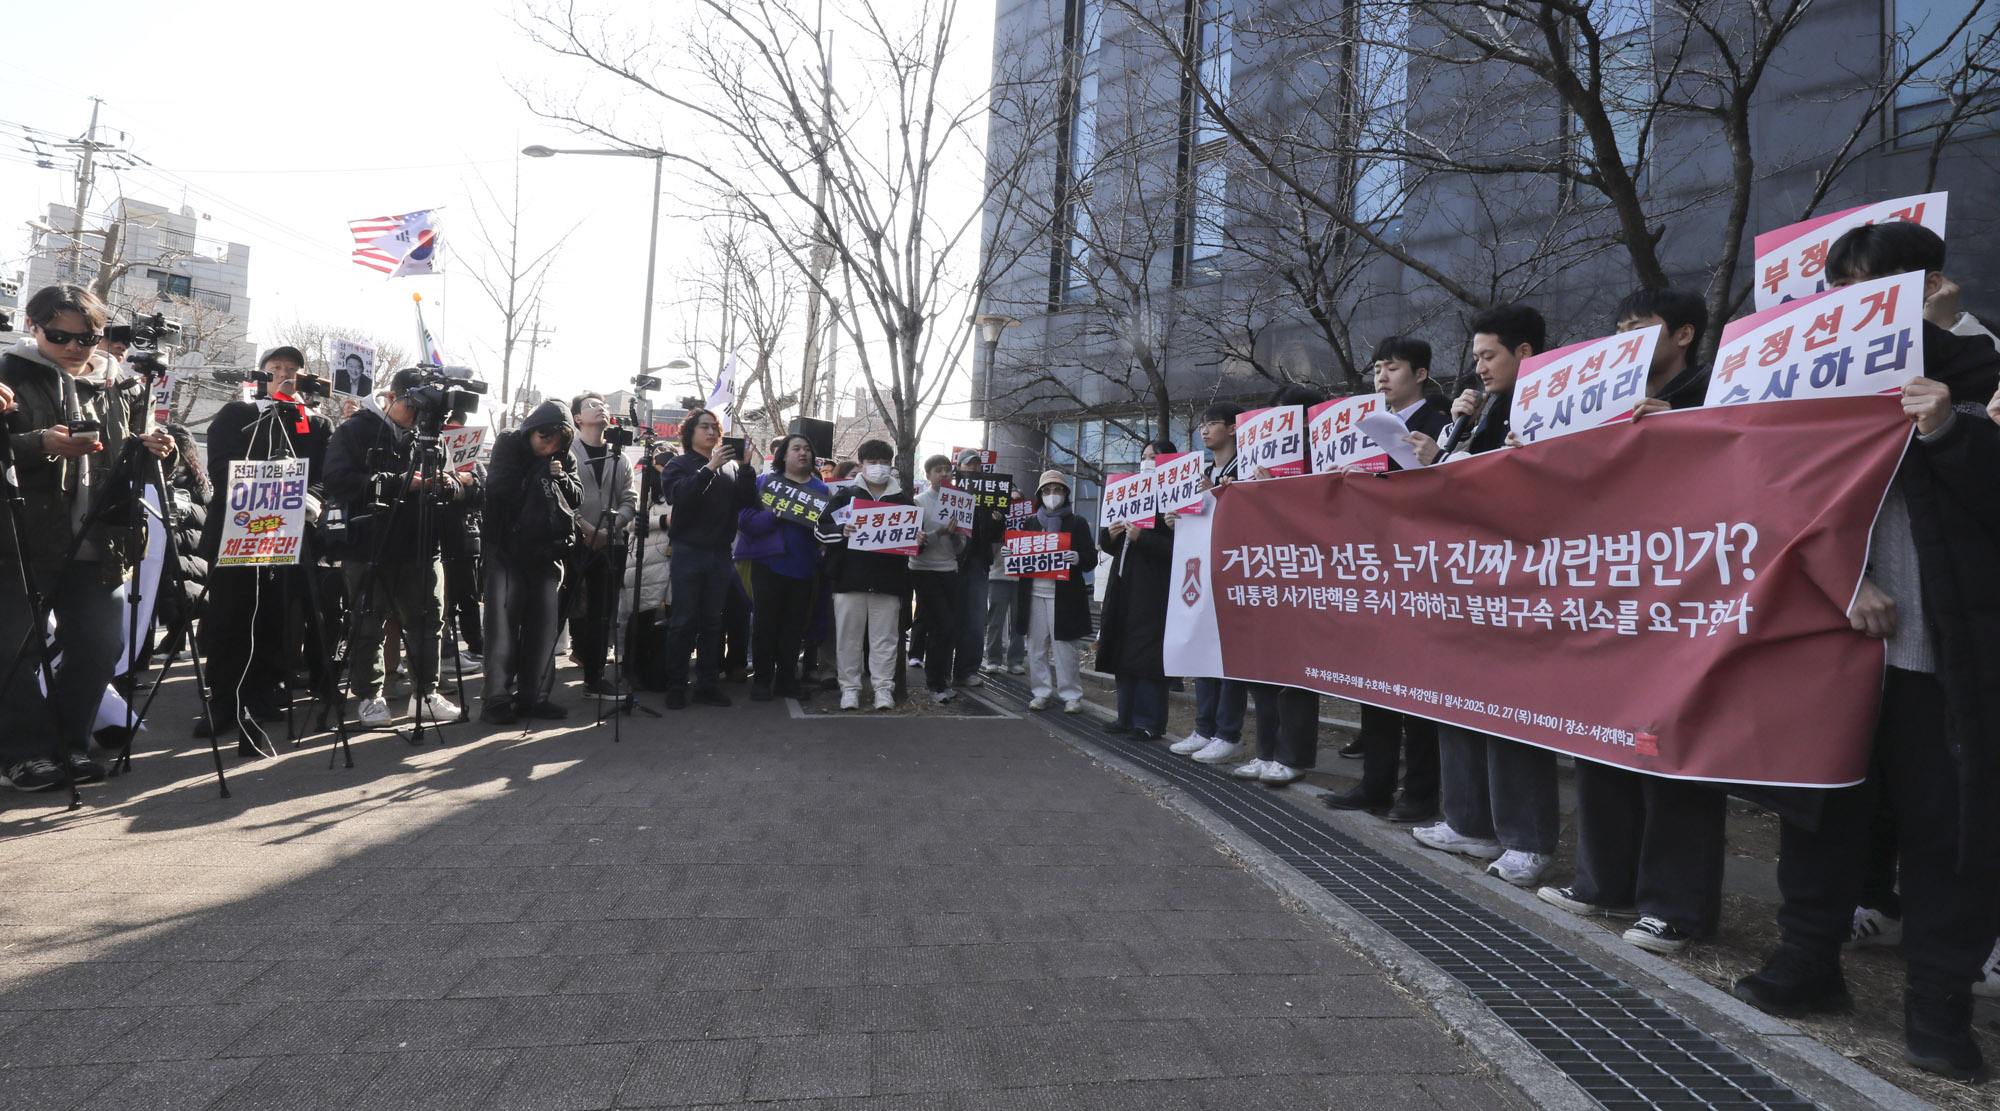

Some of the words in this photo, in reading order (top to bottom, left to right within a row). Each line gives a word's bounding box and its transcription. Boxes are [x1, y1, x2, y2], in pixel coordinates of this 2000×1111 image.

[1717, 284, 1902, 384] 부정선거
[1517, 335, 1645, 411] 부정선거
[1522, 364, 1643, 441] 수사하라
[1238, 410, 1295, 452] 부정선거
[1240, 433, 1301, 473] 수사하라
[234, 464, 258, 479] 전과
[261, 464, 283, 479] 12범
[286, 462, 306, 477] 수괴
[1157, 456, 1201, 489] 부정선거
[231, 480, 304, 511] 이재명
[768, 480, 828, 512] 사기탄핵
[958, 478, 1010, 493] 사기탄핵
[1105, 477, 1152, 505] 부정선거
[761, 492, 818, 523] 원천무효
[938, 508, 973, 524] 수사하라
[940, 492, 973, 511] 부정선거
[1106, 495, 1154, 522] 수사하라
[250, 517, 281, 533] 당장
[855, 510, 919, 529] 부정선거
[222, 537, 298, 556] 체포하라!
[856, 527, 919, 546] 수사하라
[1006, 533, 1059, 555] 대통령을
[1006, 551, 1070, 574] 석방하라
[1222, 543, 1324, 579] 거짓말과
[1330, 543, 1389, 585] 선동,
[1393, 540, 1439, 583] 누가
[1444, 539, 1517, 586] 진짜
[1522, 522, 1758, 587] 내란범인가?
[1227, 585, 1279, 607] 대통령
[1282, 586, 1360, 613] 사기탄핵을
[1363, 589, 1396, 615] 즉시
[1400, 590, 1464, 620] 각하하고
[1466, 594, 1554, 630] 불법구속
[1560, 598, 1639, 635] 취소를
[1648, 592, 1753, 638] 요구한다
[1319, 669, 1364, 689] 자유민주주의를
[1365, 679, 1392, 694] 수호하는
[1409, 688, 1438, 705] 서강인들
[1464, 698, 1486, 715] 2025.
[1487, 703, 1501, 717] 02.
[1502, 706, 1513, 720] 27
[1514, 708, 1531, 725] (목)
[1532, 713, 1558, 729] 14:00
[1564, 719, 1589, 736] 장소:
[1589, 725, 1636, 747] 서강대학교
